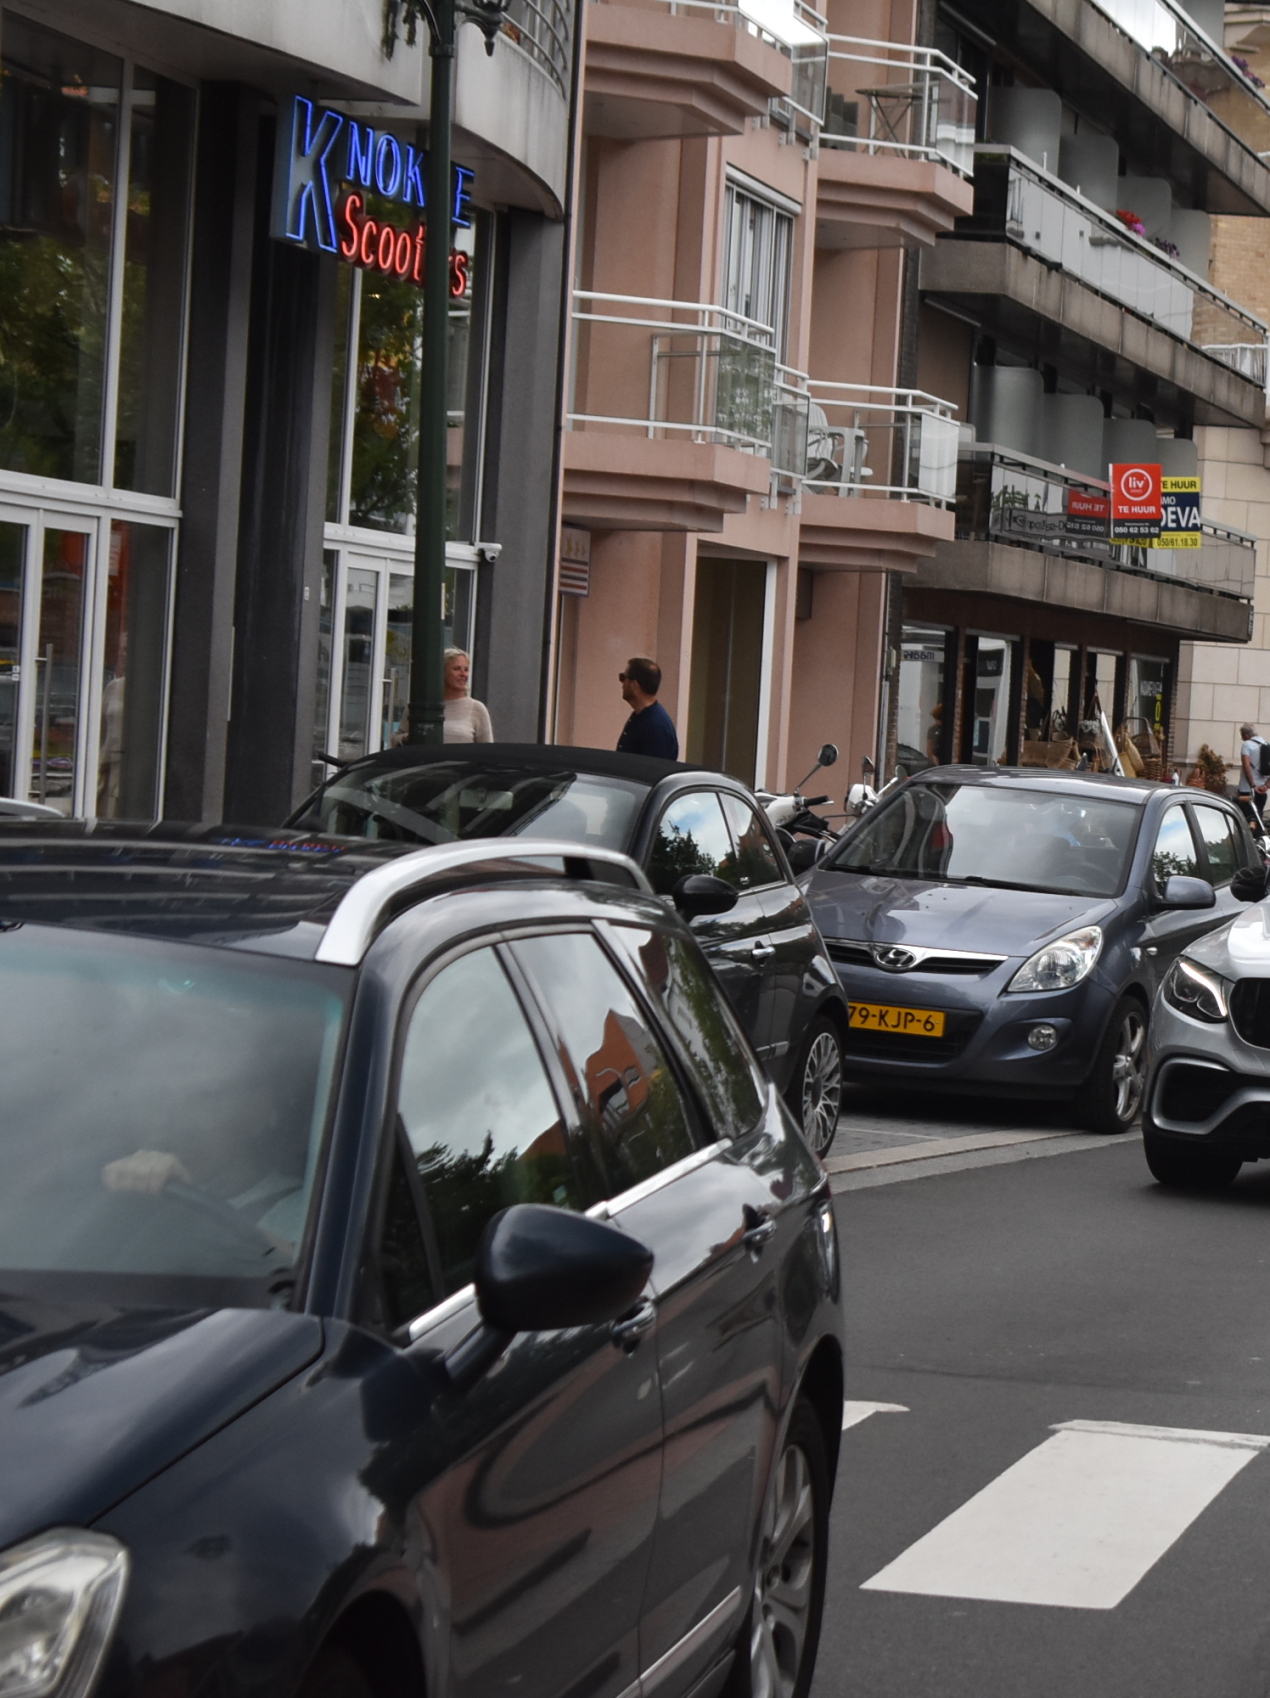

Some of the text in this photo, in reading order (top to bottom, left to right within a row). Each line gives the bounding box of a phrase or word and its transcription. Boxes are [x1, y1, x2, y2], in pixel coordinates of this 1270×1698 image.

[1171, 481, 1197, 489] HUUR
[1118, 505, 1156, 513] TE HUUR
[1114, 526, 1159, 534] 050 62 53 62
